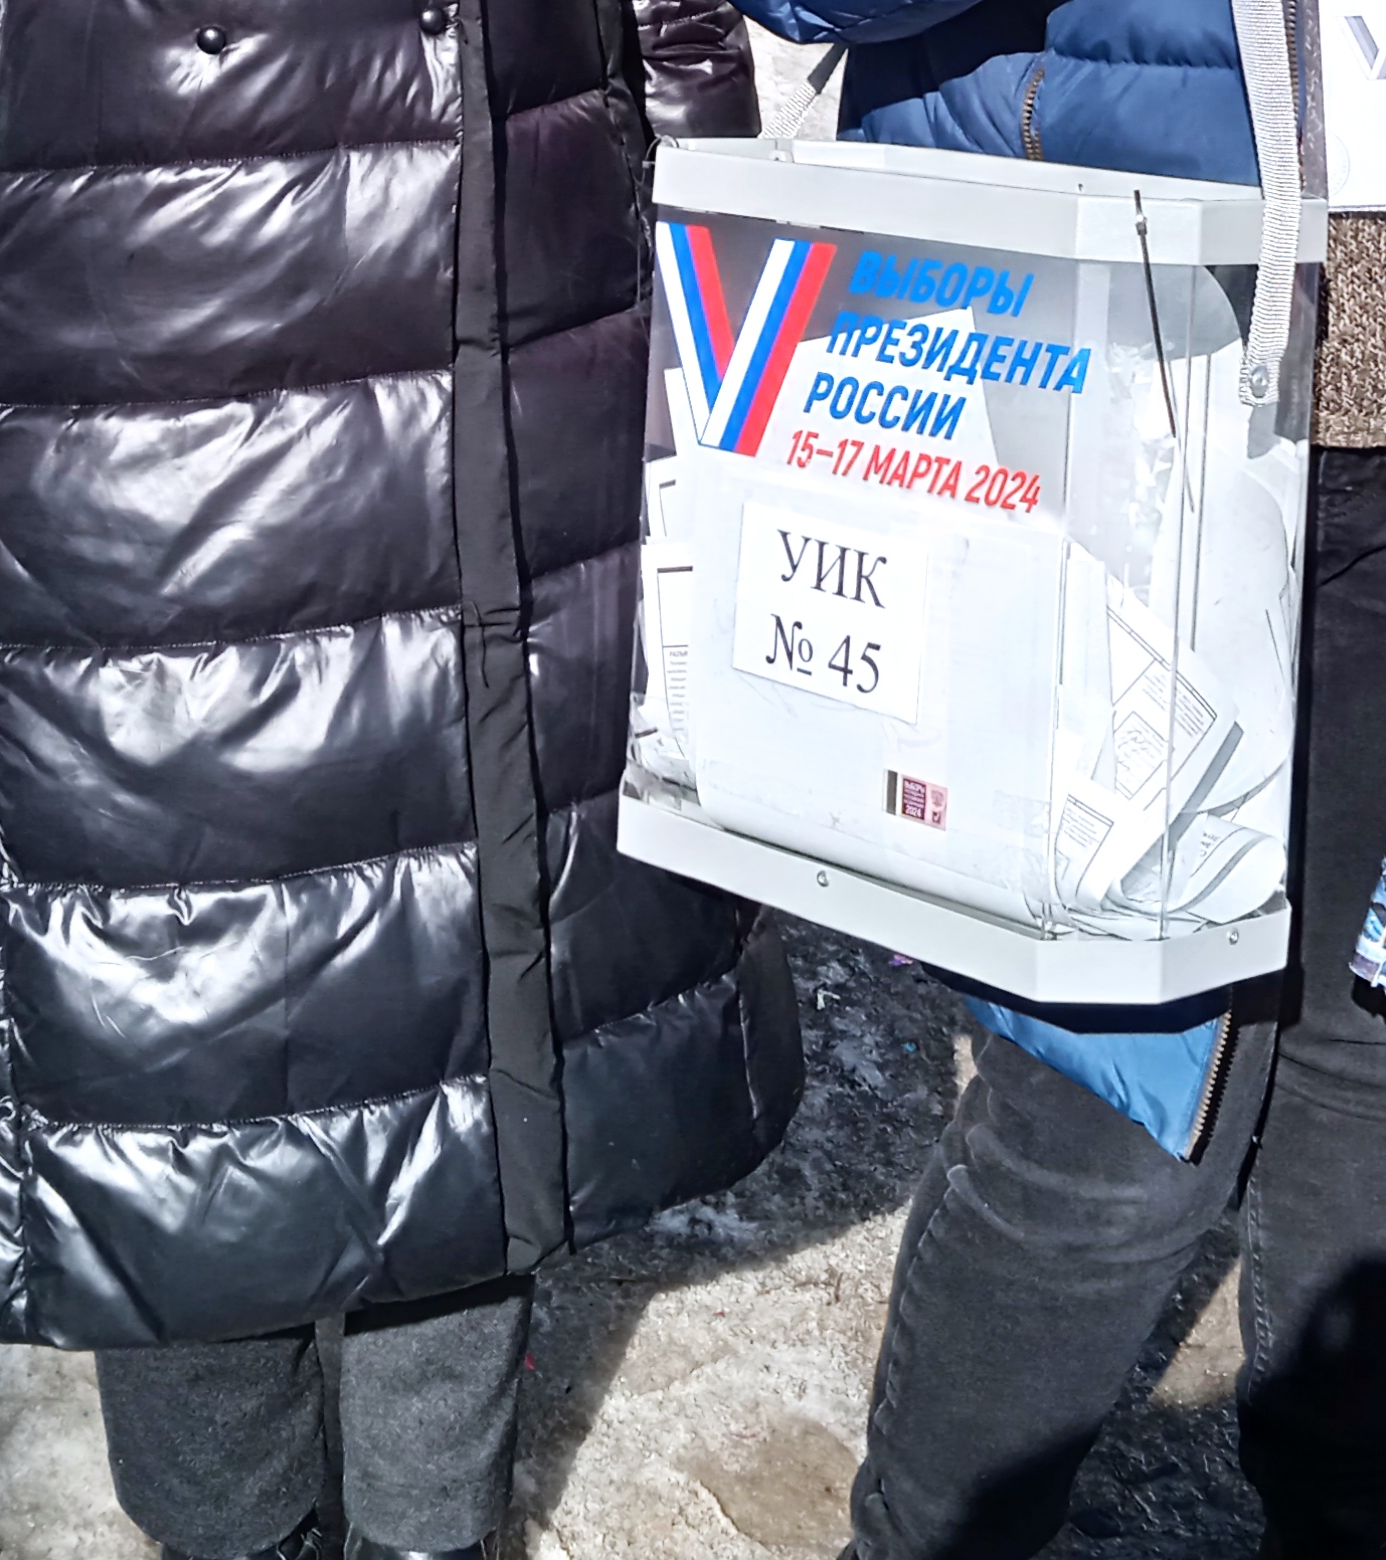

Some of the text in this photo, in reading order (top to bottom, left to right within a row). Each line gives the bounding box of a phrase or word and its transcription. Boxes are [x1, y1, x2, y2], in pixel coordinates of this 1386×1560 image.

[849, 250, 1034, 318] ВЫБОРЫ
[826, 310, 1091, 394] ПРЕЗИДЕНТА
[803, 371, 967, 440] РОССИИ
[862, 444, 963, 499] МАРТА
[964, 464, 1041, 513] 2024
[777, 529, 887, 609] УИК
[765, 613, 881, 693] № 45
